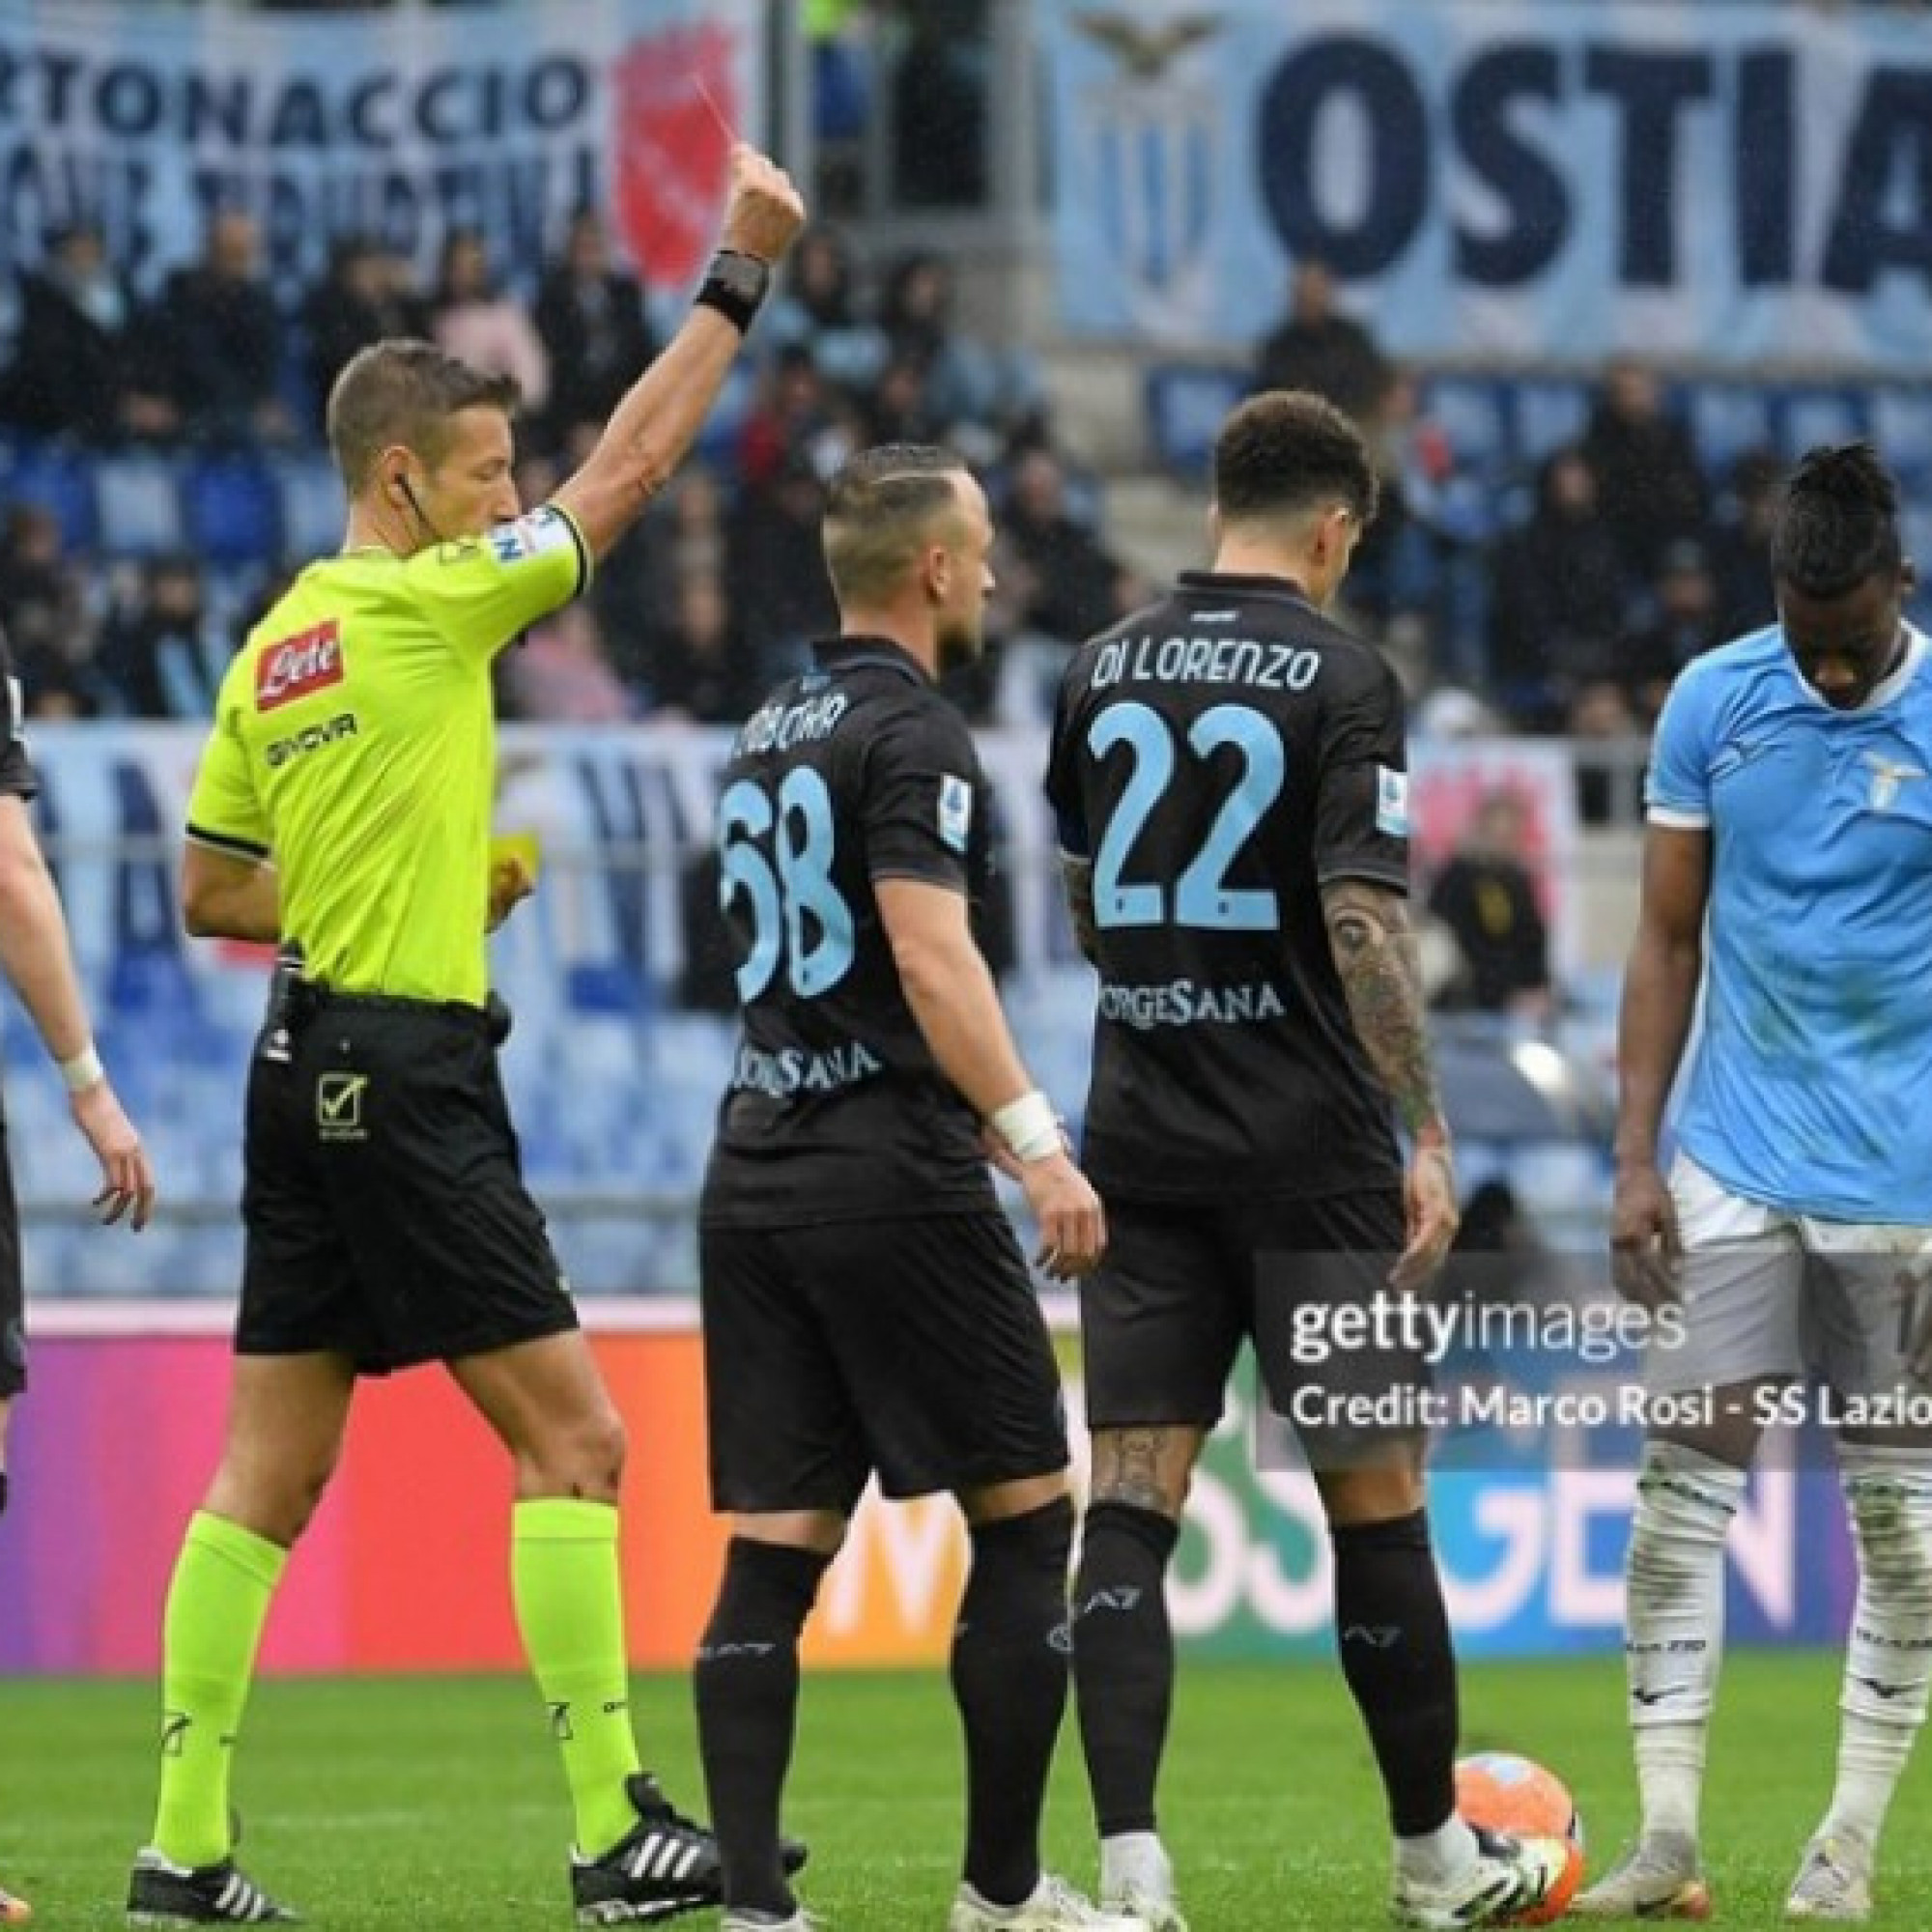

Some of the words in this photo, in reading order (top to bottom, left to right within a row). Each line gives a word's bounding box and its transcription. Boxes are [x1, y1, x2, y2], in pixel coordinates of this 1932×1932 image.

[1092, 639, 1125, 690] DI
[1134, 635, 1321, 691] LORENZO
[720, 764, 856, 1005] 68
[1088, 700, 1285, 929] 22
